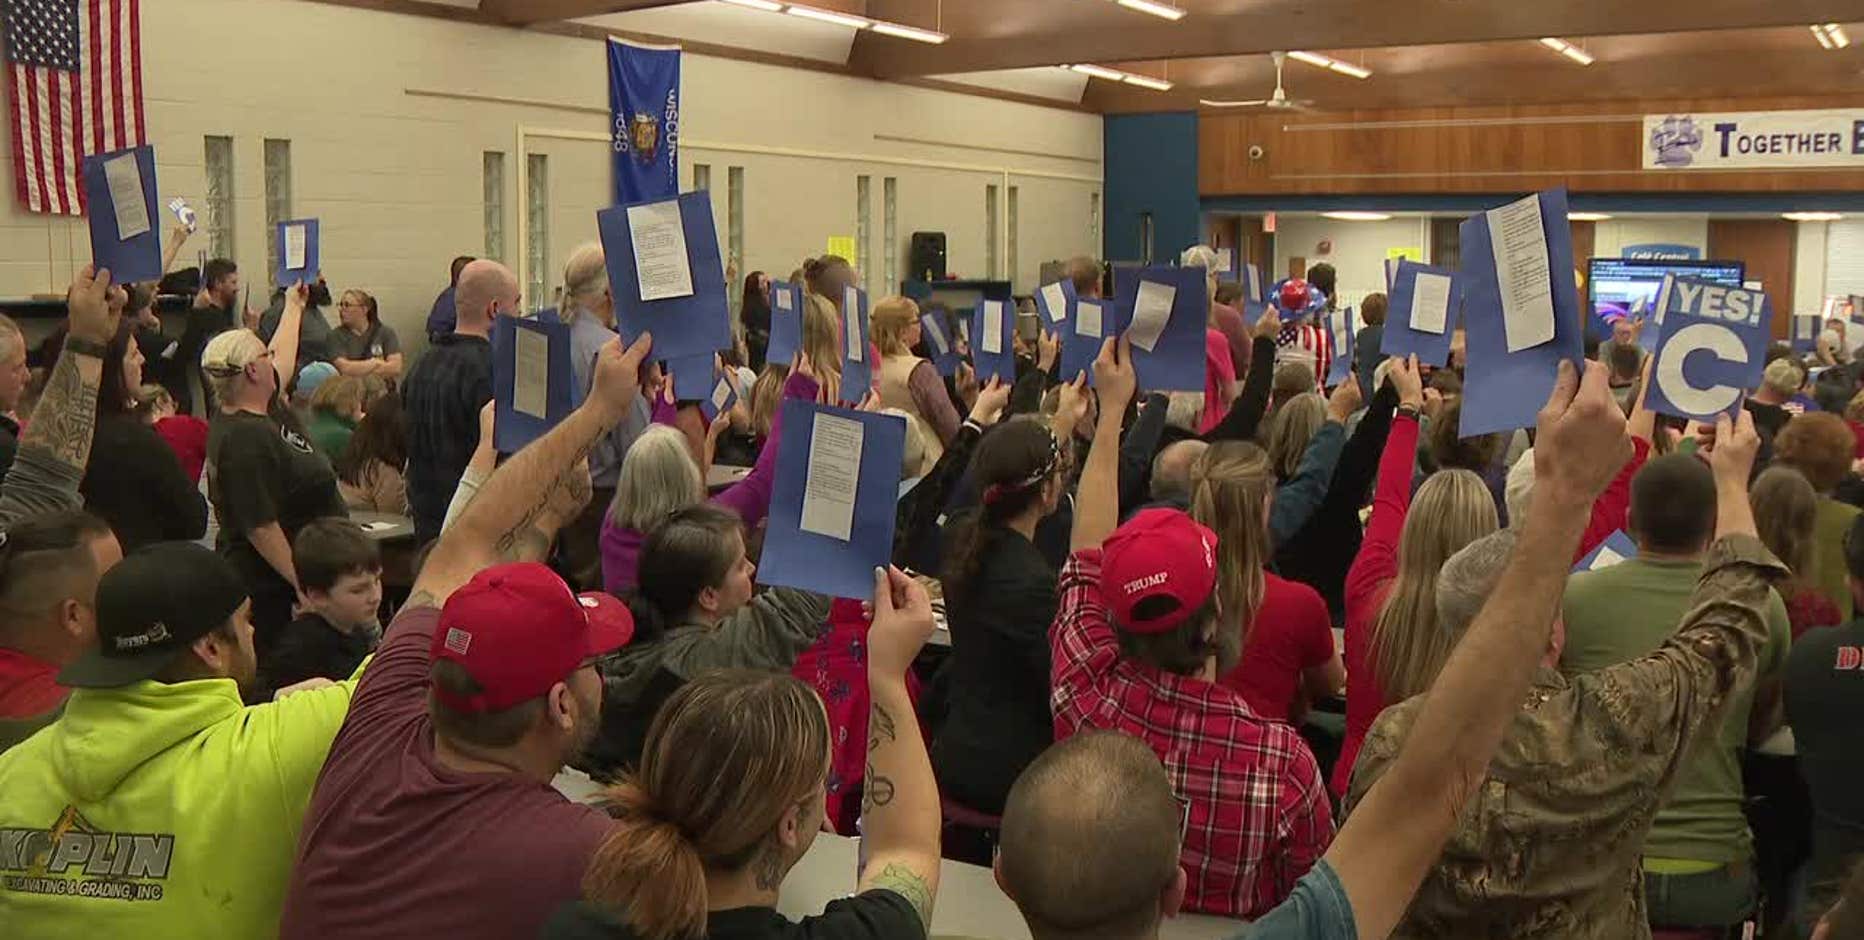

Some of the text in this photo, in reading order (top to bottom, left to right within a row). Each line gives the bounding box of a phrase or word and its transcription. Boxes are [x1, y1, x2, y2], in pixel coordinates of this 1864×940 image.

[1714, 123, 1842, 158] TOGETHER
[1676, 282, 1765, 325] YES!
[1656, 323, 1748, 415] C
[1123, 571, 1168, 595] TRUMP
[78, 880, 133, 900] GRADING,
[136, 885, 162, 900] INC
